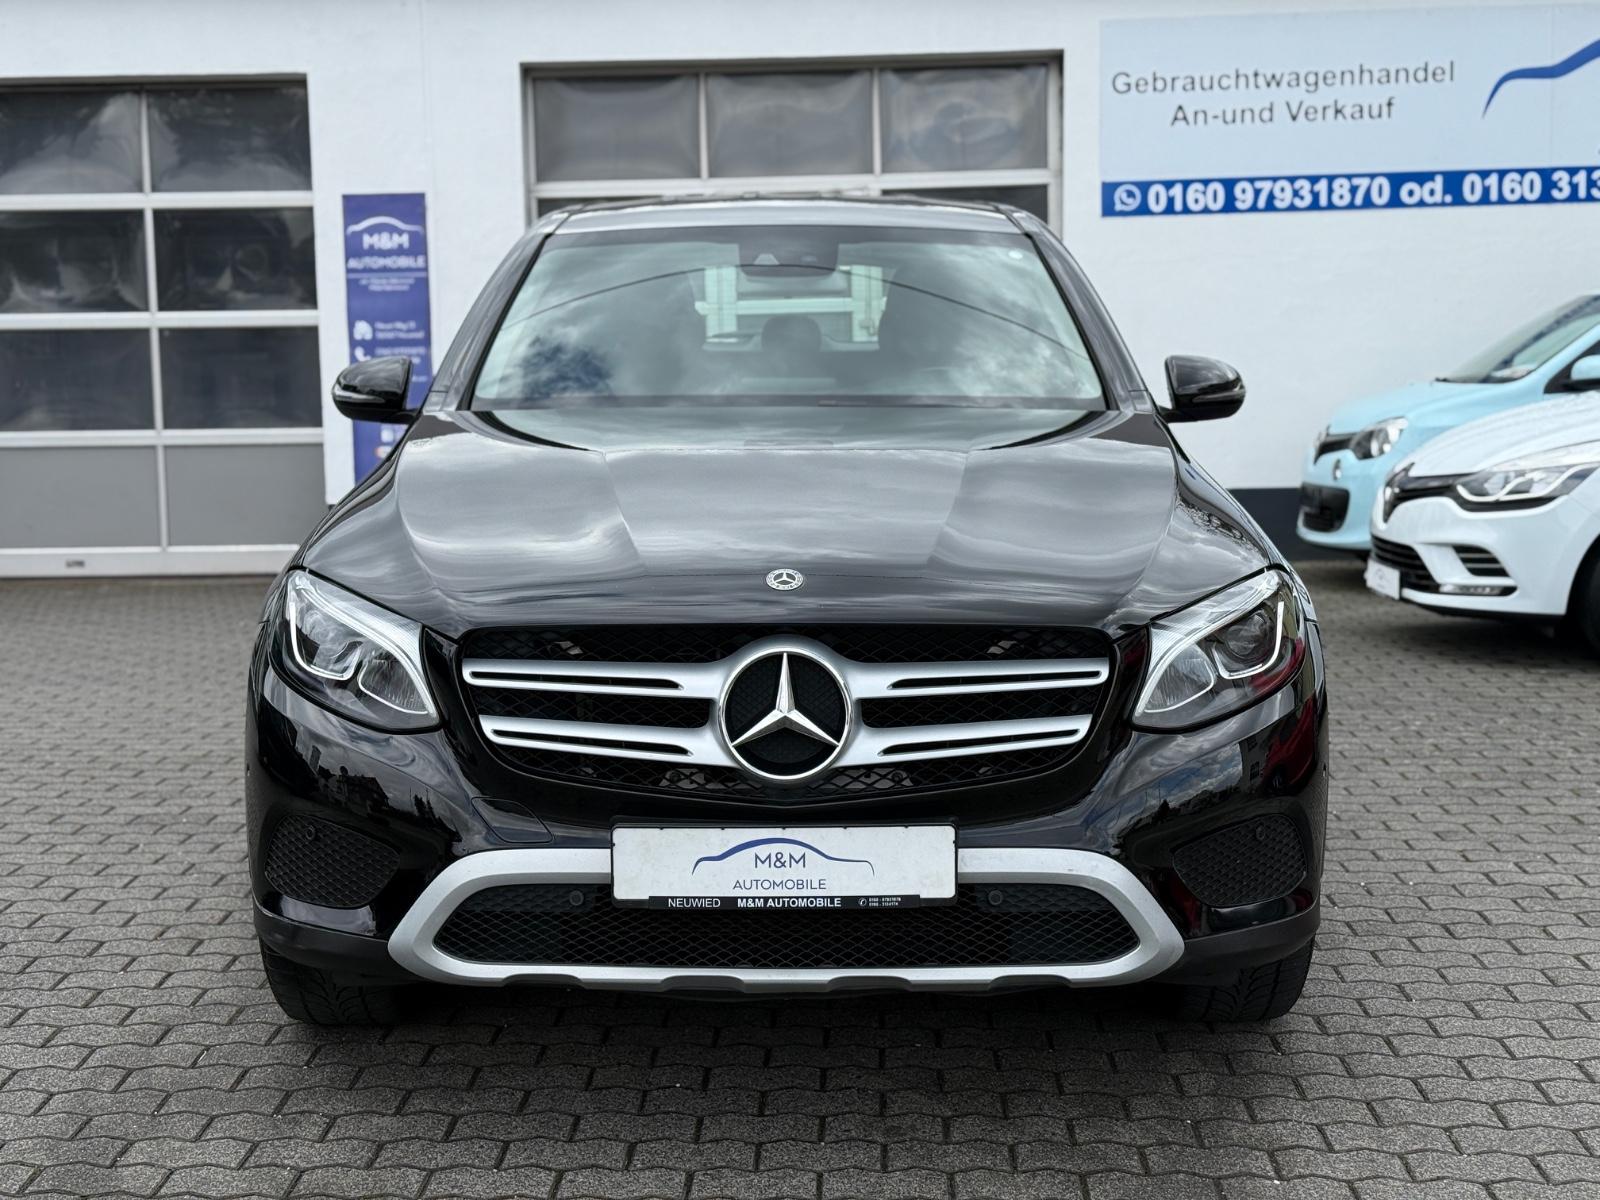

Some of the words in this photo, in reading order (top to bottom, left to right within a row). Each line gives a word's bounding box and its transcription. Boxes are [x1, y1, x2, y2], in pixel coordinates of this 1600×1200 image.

[1112, 60, 1454, 95] Gebrauchtwagenhandel
[1170, 101, 1274, 127] An-und
[1285, 97, 1395, 122] Verkauf
[1147, 182, 1226, 213] 0160
[1233, 176, 1391, 210] 97931870
[1400, 174, 1453, 205] od.
[1462, 171, 1542, 203] 0160
[362, 231, 410, 250] M&M
[346, 255, 426, 270] AUTOMOBILE
[755, 852, 806, 869] M&M
[733, 878, 827, 890] AUTOMOBILE
[668, 898, 721, 908] NEUWIED
[737, 898, 764, 908] M&M
[767, 897, 842, 908] AUTOMOBILE
